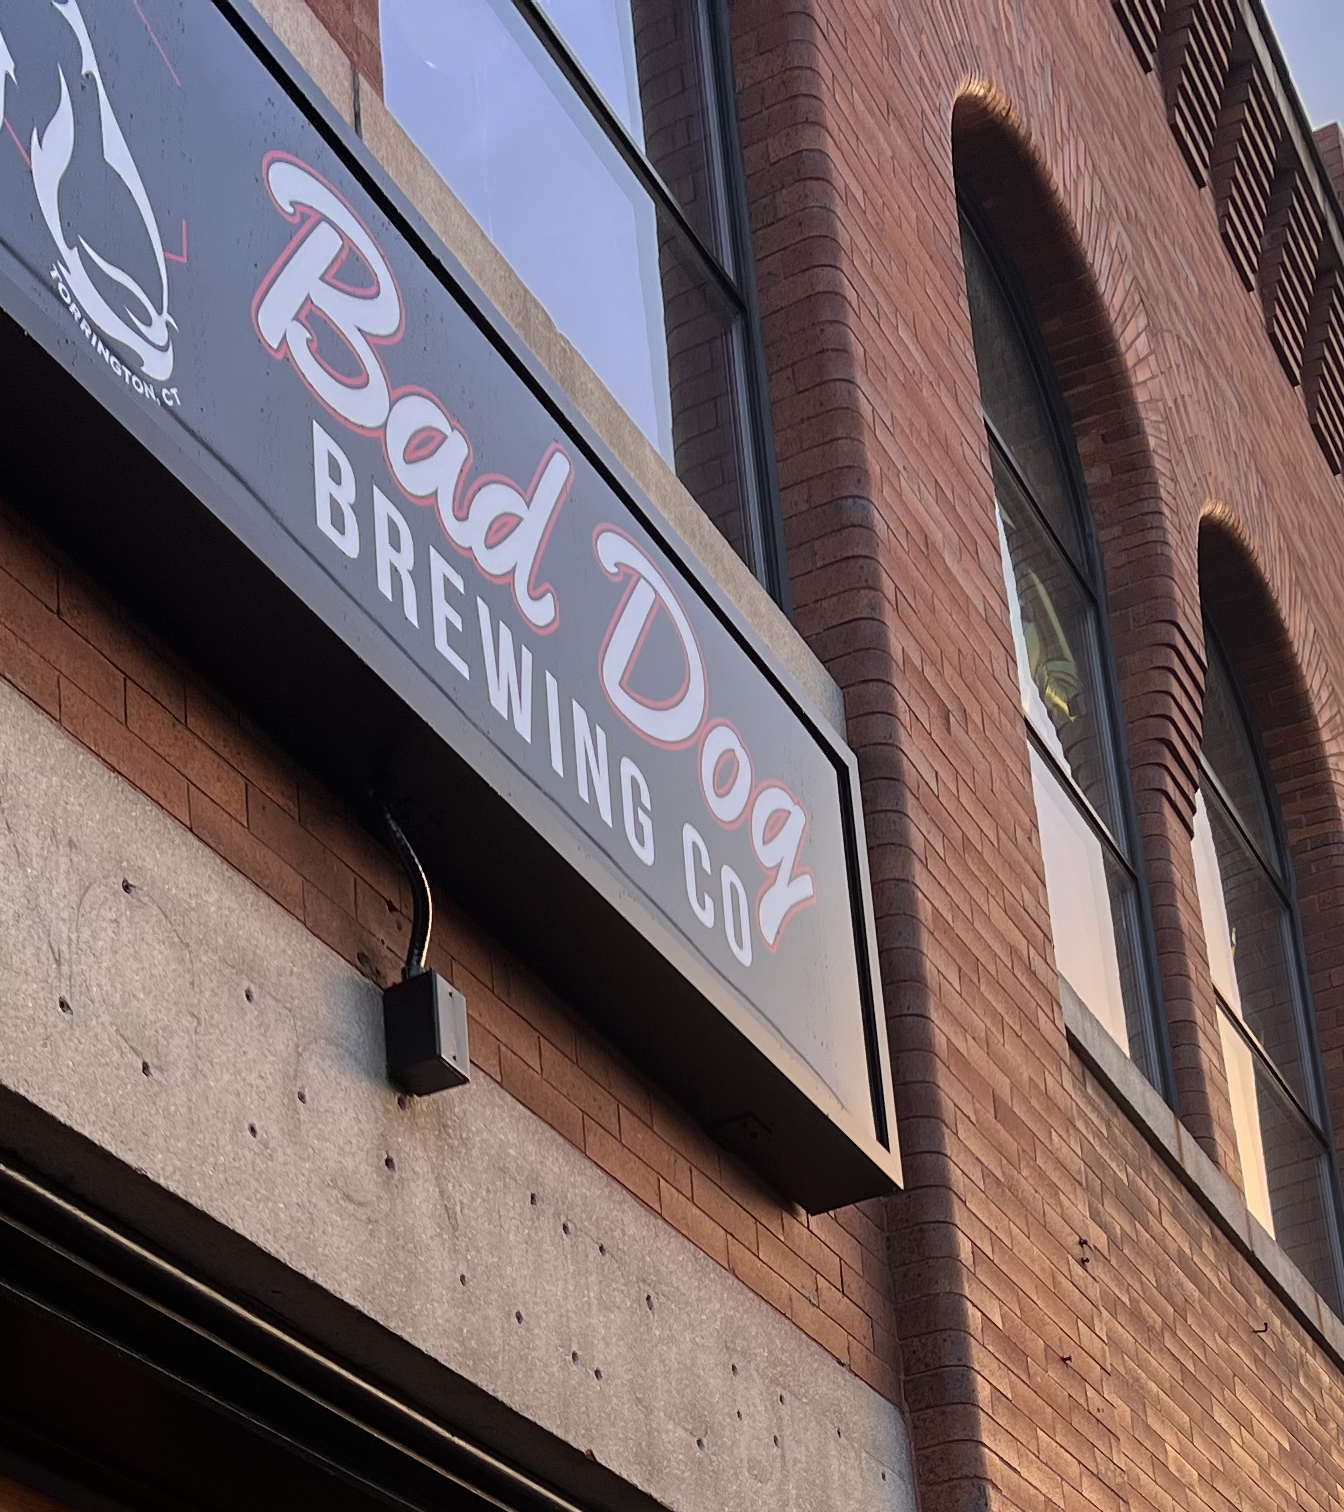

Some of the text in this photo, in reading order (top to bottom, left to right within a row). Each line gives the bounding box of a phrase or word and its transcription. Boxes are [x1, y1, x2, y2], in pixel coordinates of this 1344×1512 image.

[161, 387, 182, 407] CT
[251, 151, 817, 951] Bad Dog
[312, 419, 753, 968] BREWING CO
